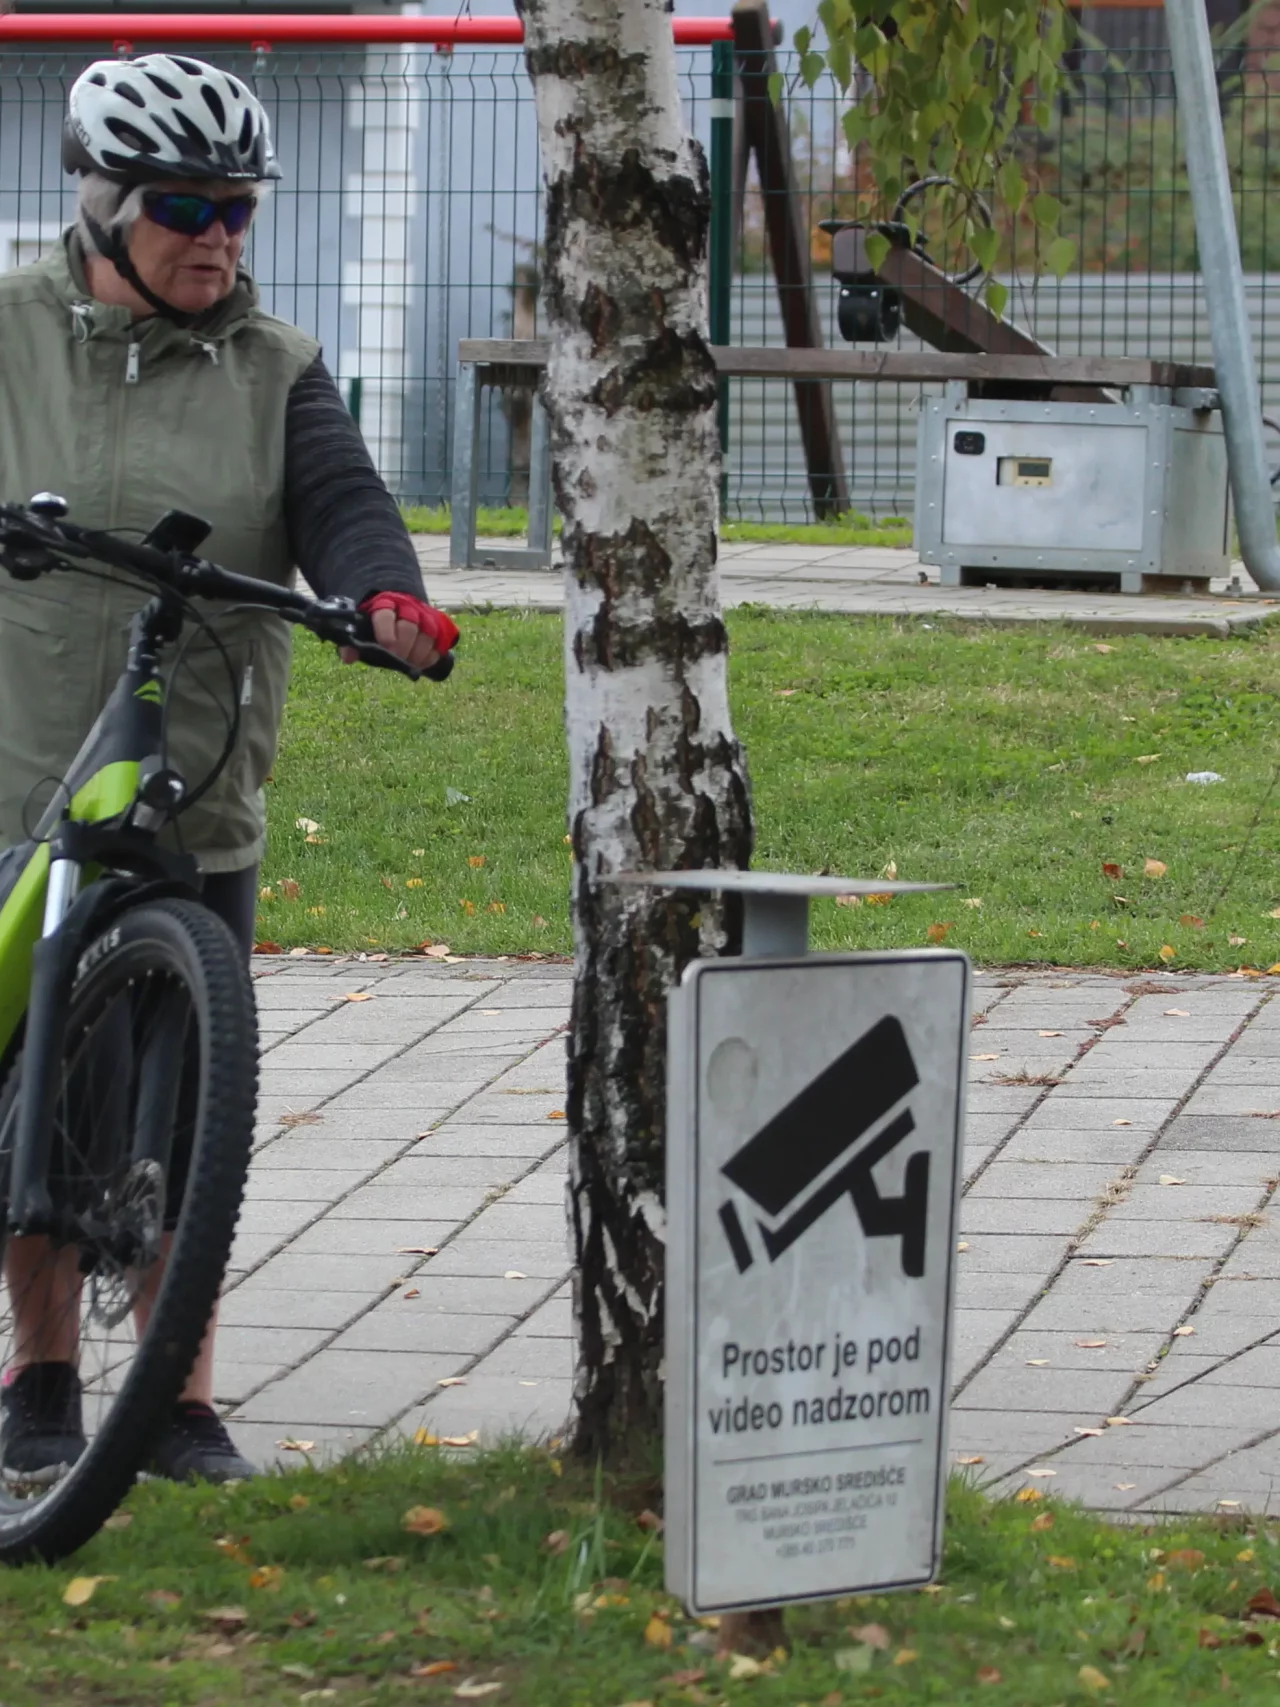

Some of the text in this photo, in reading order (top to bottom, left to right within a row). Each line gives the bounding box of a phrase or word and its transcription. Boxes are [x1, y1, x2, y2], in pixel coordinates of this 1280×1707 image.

[722, 1326, 921, 1378] Prostor je pod
[709, 1386, 930, 1434] video nadzorom
[726, 1482, 768, 1504] GRAD
[770, 1475, 832, 1499] MURSKO
